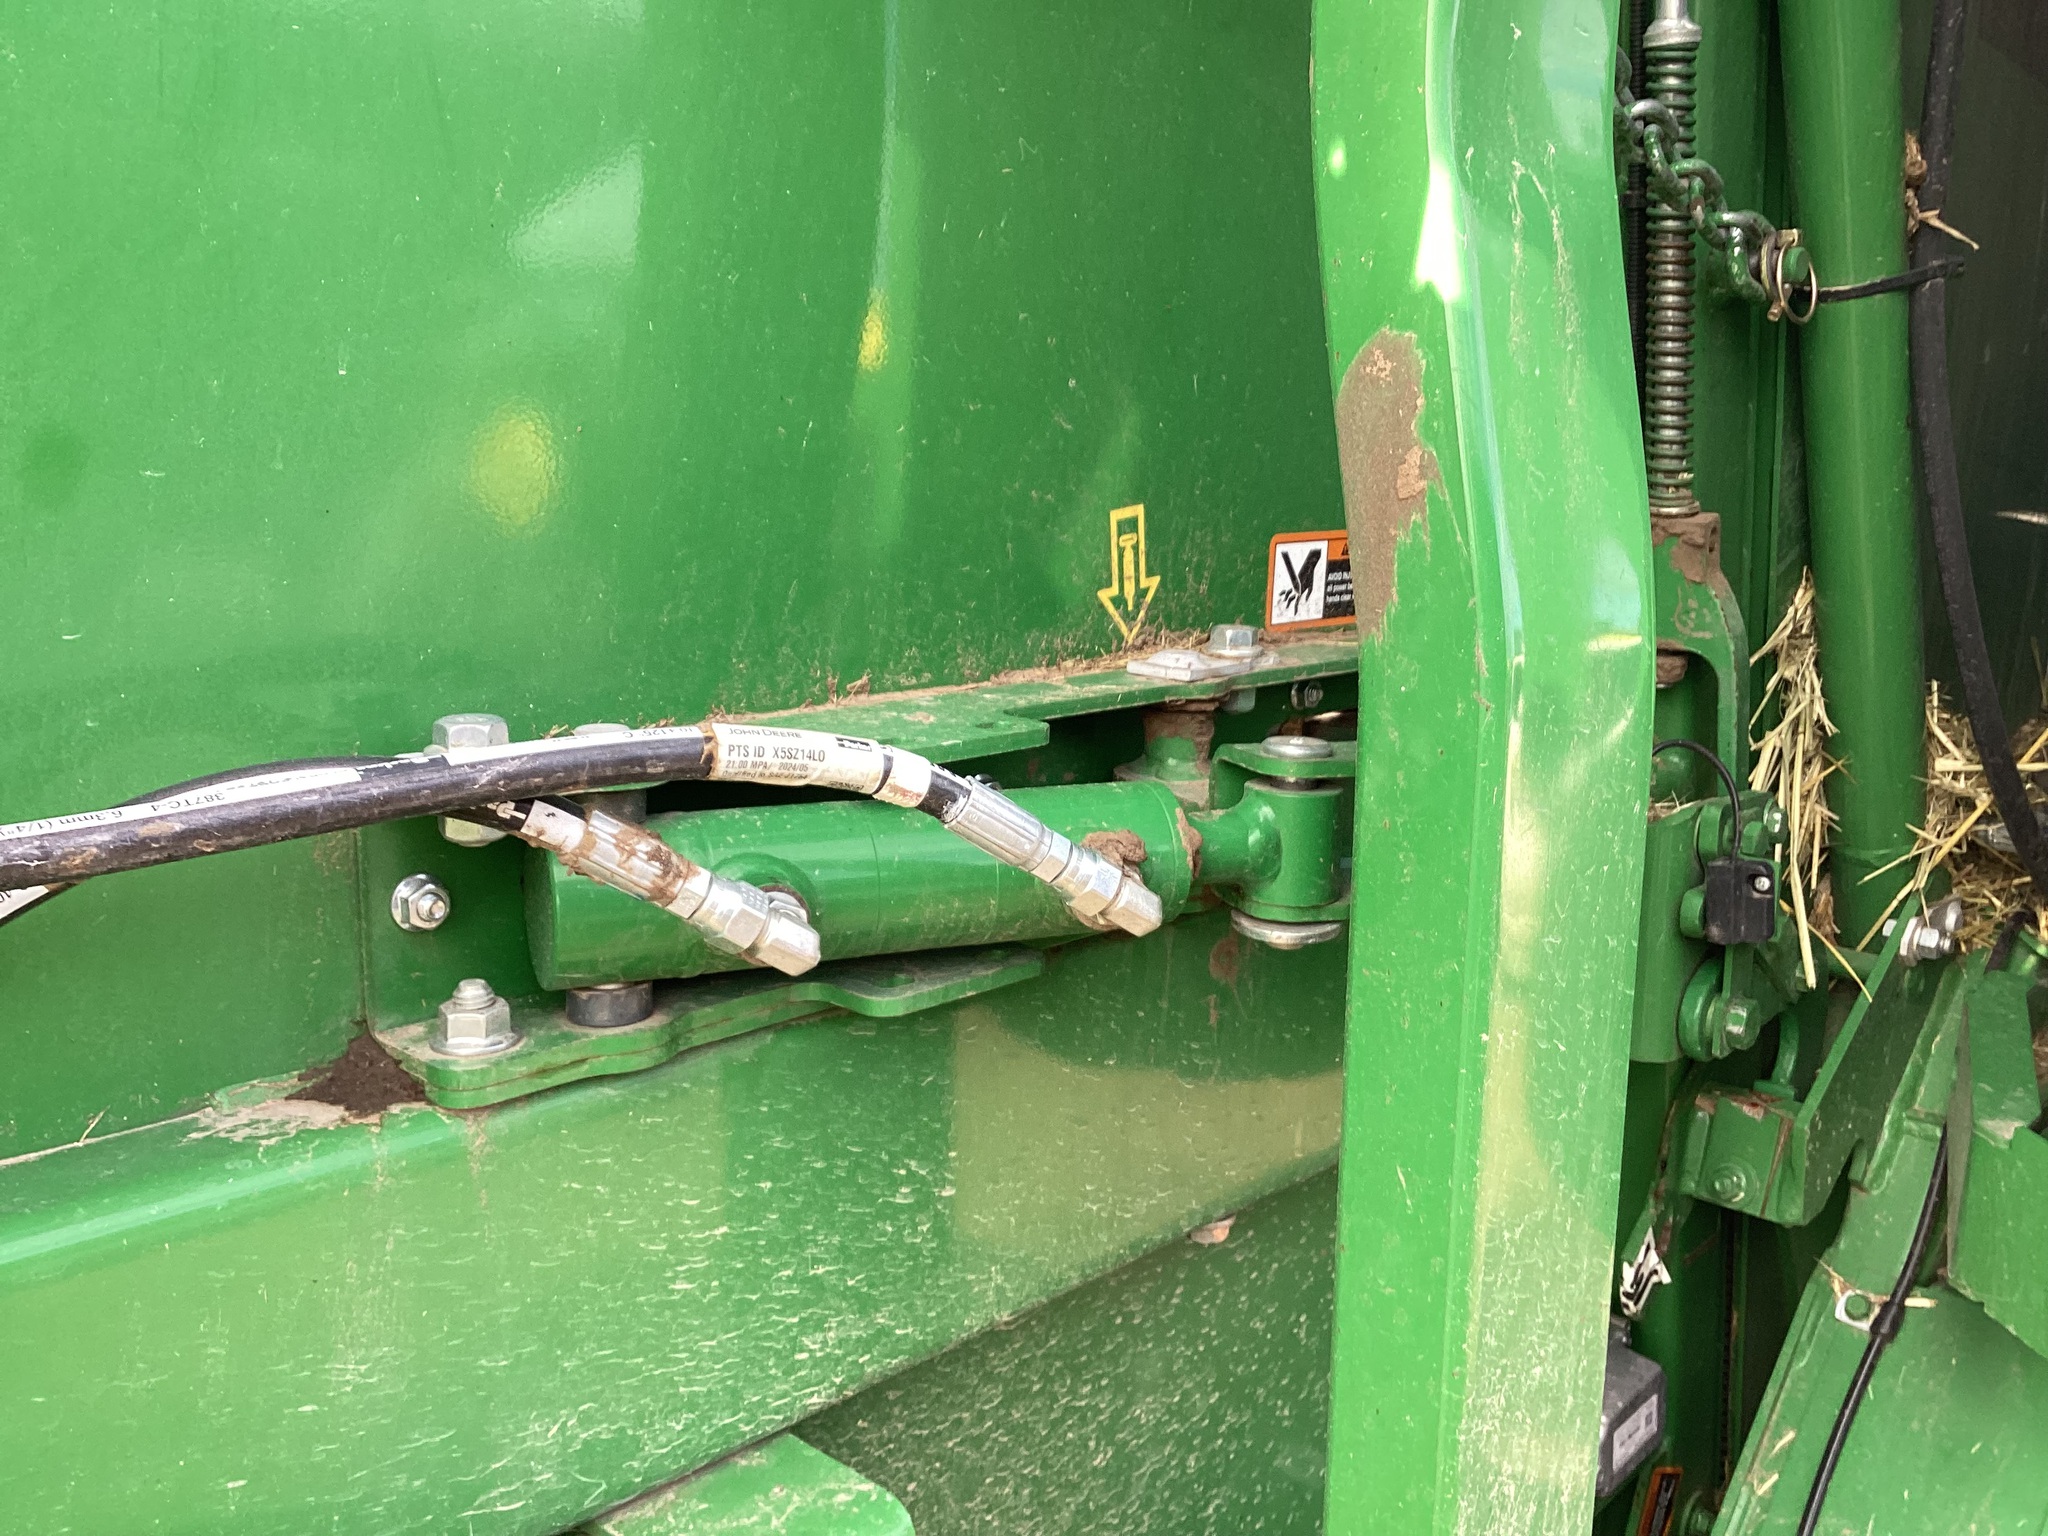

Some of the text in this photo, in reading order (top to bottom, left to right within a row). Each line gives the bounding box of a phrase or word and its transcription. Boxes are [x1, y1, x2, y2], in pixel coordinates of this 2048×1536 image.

[1327, 571, 1342, 581] AVOID
[1326, 594, 1339, 602] hands
[729, 728, 802, 739] JOHN DEERE
[728, 744, 750, 758] PTS
[753, 745, 766, 758] ID
[725, 759, 748, 769] 21.00
[778, 761, 809, 772] 2024/05
[150, 792, 226, 812] 387TC-4
[58, 808, 123, 825] 6.3mm
